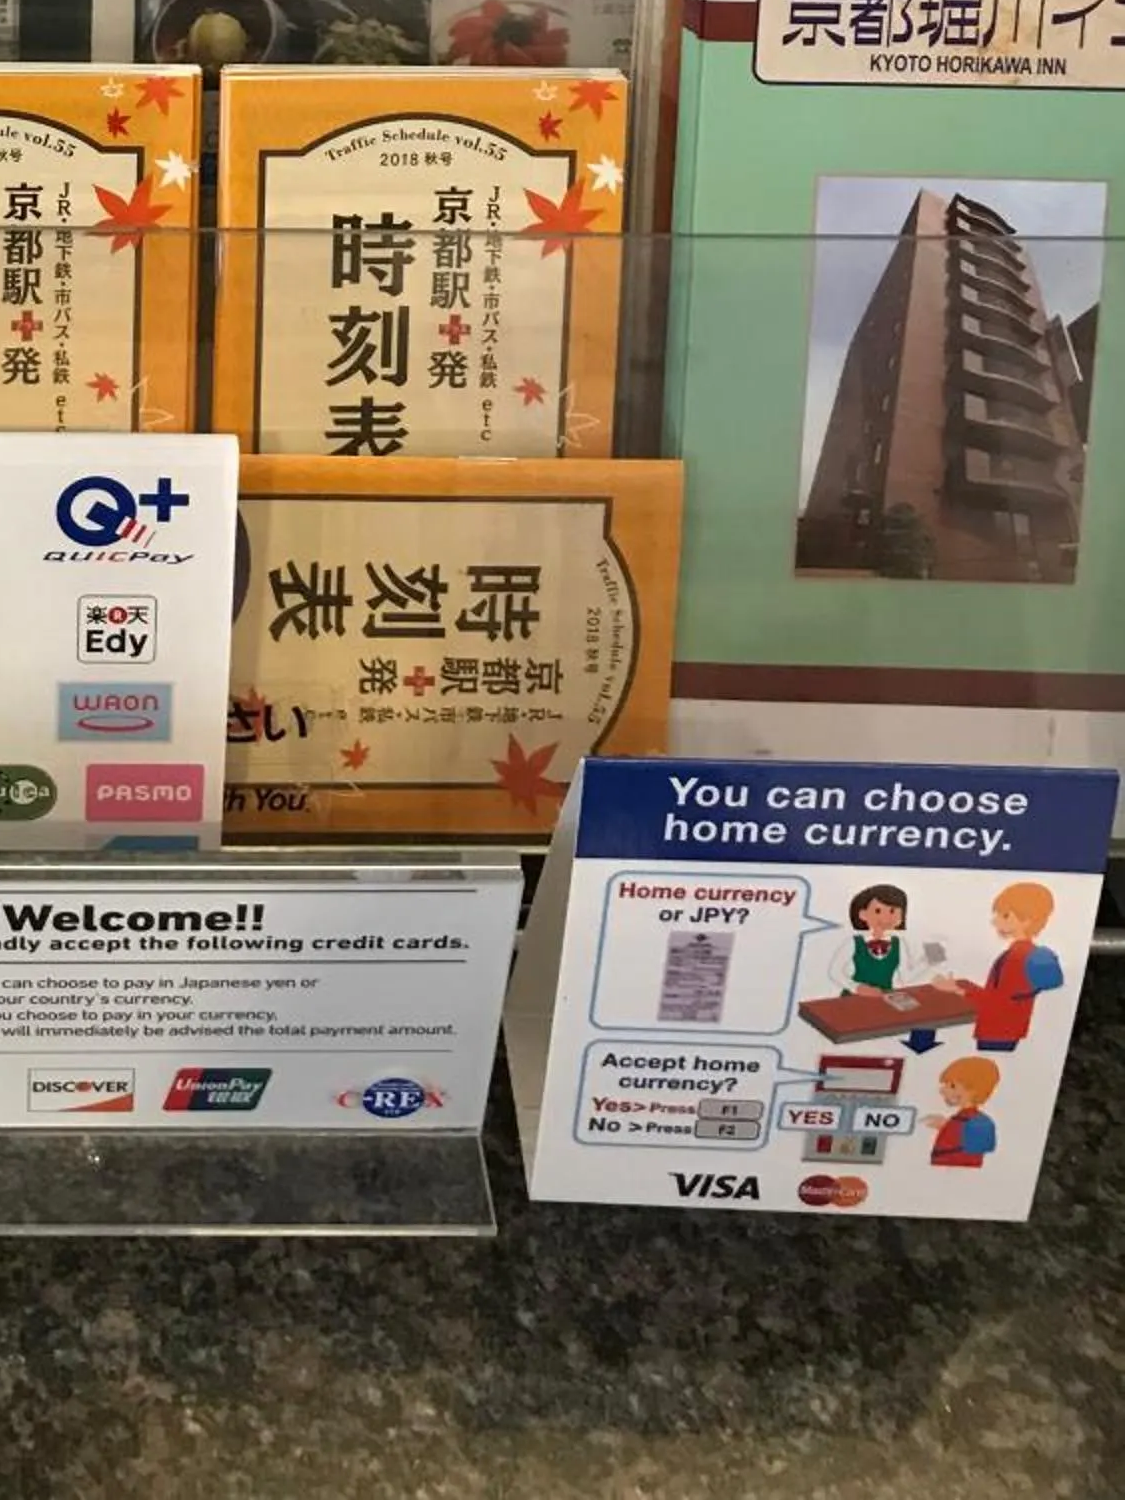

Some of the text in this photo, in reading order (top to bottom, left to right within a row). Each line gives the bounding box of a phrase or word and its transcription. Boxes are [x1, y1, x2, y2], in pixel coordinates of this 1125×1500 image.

[869, 55, 1067, 77] KYOTO HORIKAWA INN
[378, 151, 420, 167] 2018
[42, 550, 195, 566] QUICPay
[268, 560, 542, 643] 時刻表
[86, 629, 148, 657] Edy
[73, 693, 160, 712] WAON
[97, 785, 193, 801] PASMO
[669, 775, 1029, 817] You can choose
[664, 813, 1013, 856] home currency.
[618, 881, 797, 906] Home currency
[6, 903, 265, 932] Welcome!!
[658, 906, 750, 925] or JPY?
[49, 936, 131, 953] accept
[140, 936, 179, 951] the
[186, 935, 304, 953] following
[312, 935, 385, 950] credit
[392, 935, 470, 950] cards.
[2, 978, 34, 990] can
[37, 977, 99, 989] choose
[123, 978, 155, 992] pay
[178, 977, 262, 992] Japanese
[265, 978, 296, 992] yen
[114, 994, 194, 1008] currency.
[16, 1010, 77, 1022] choose
[102, 1011, 133, 1024] pay
[156, 1010, 195, 1023] your
[199, 1010, 278, 1024] currency.
[1, 1025, 31, 1037] will
[35, 1025, 138, 1040] immediately
[143, 1025, 165, 1037] be
[169, 1024, 235, 1037] advised
[238, 1024, 266, 1037] the
[269, 1024, 307, 1037] total
[310, 1025, 384, 1040] payment
[388, 1024, 457, 1037] amount.
[601, 1052, 760, 1074] Accept home
[32, 1080, 129, 1094] DISCOVER
[176, 1078, 263, 1095] UnionPay
[617, 1074, 739, 1094] currency?
[649, 1101, 697, 1117] Press
[787, 1108, 901, 1129] YES NO
[589, 1117, 693, 1136] No Press
[669, 1171, 761, 1200] VISA
